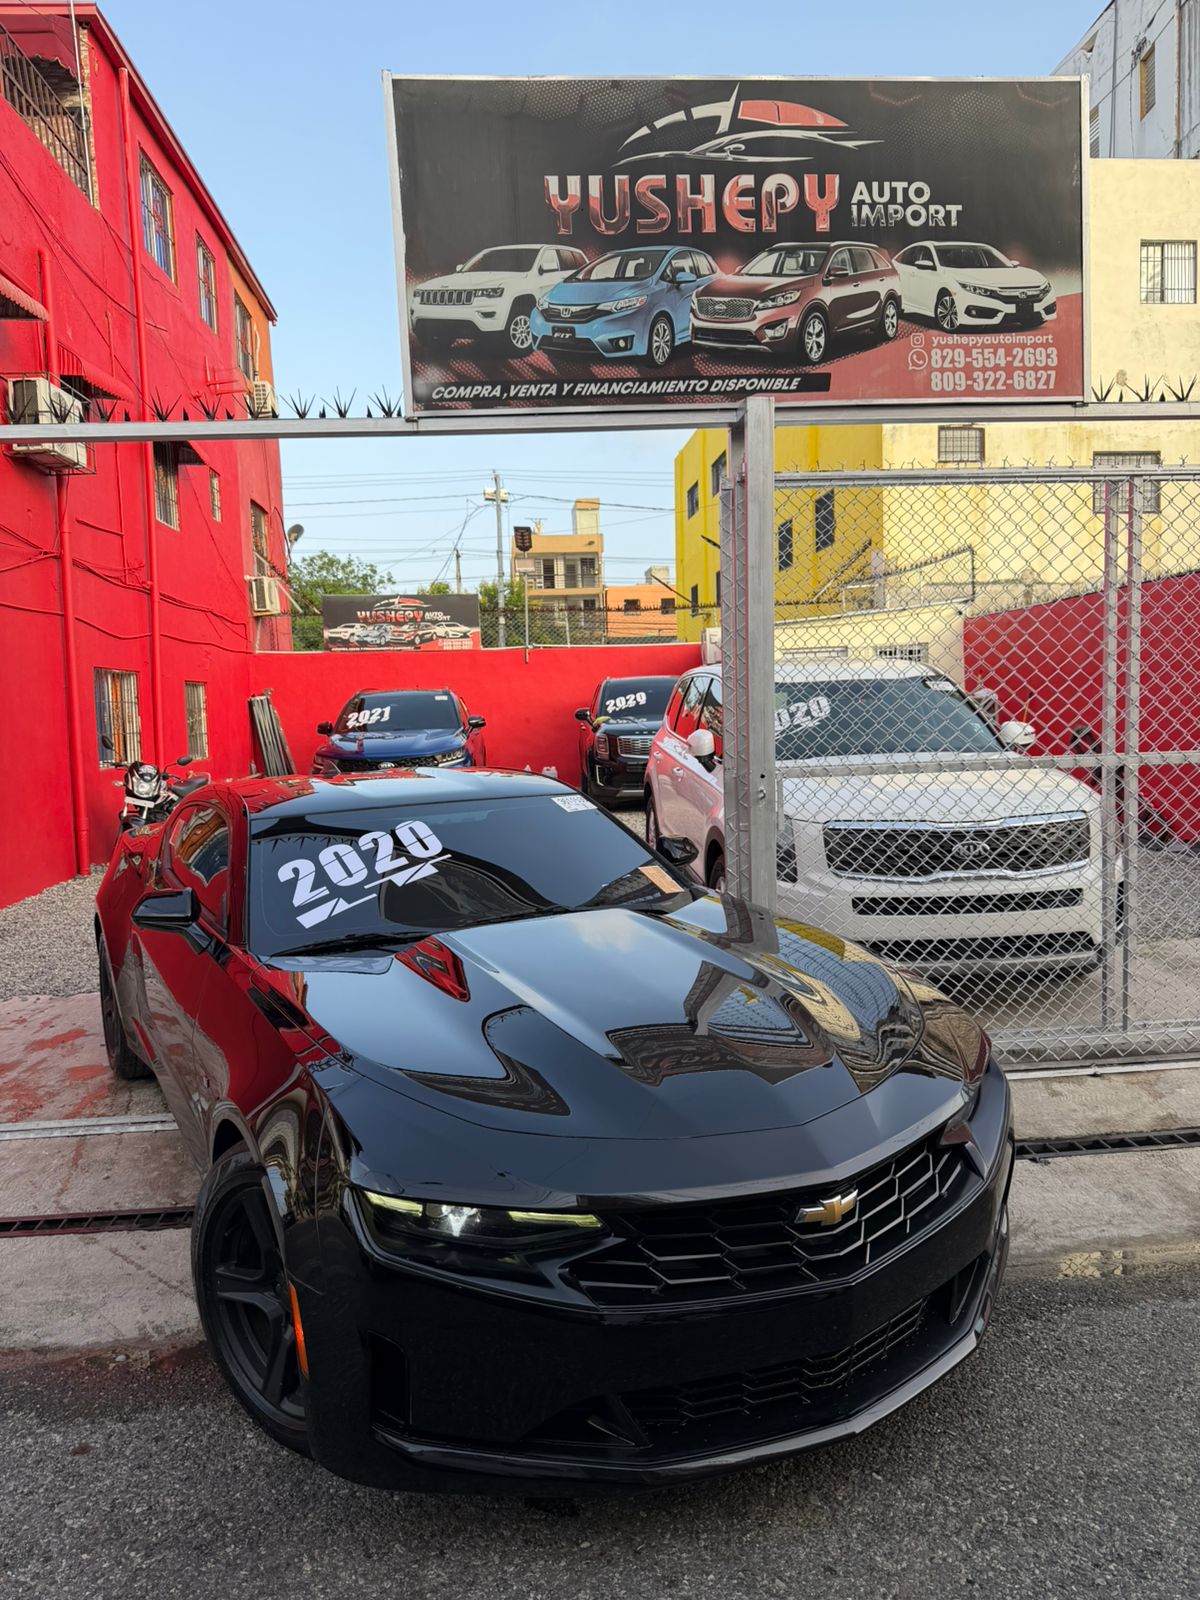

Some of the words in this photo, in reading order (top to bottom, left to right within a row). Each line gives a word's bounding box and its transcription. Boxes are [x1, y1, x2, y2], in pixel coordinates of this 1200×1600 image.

[544, 173, 840, 235] YUSHEPY
[851, 181, 931, 204] AUTO
[851, 204, 963, 227] IMPORT
[932, 333, 1054, 347] yushepyautoimport
[930, 347, 1058, 369] 829-554-2693
[431, 385, 502, 400] COMPRA
[561, 383, 573, 396] Y
[574, 379, 709, 396] FINANCIAMIENTO
[710, 377, 801, 392] DISPONIBLE
[930, 370, 1057, 391] 809-322-6827
[347, 706, 391, 727] 2021
[775, 696, 831, 731] 020
[278, 820, 443, 908] 2020
